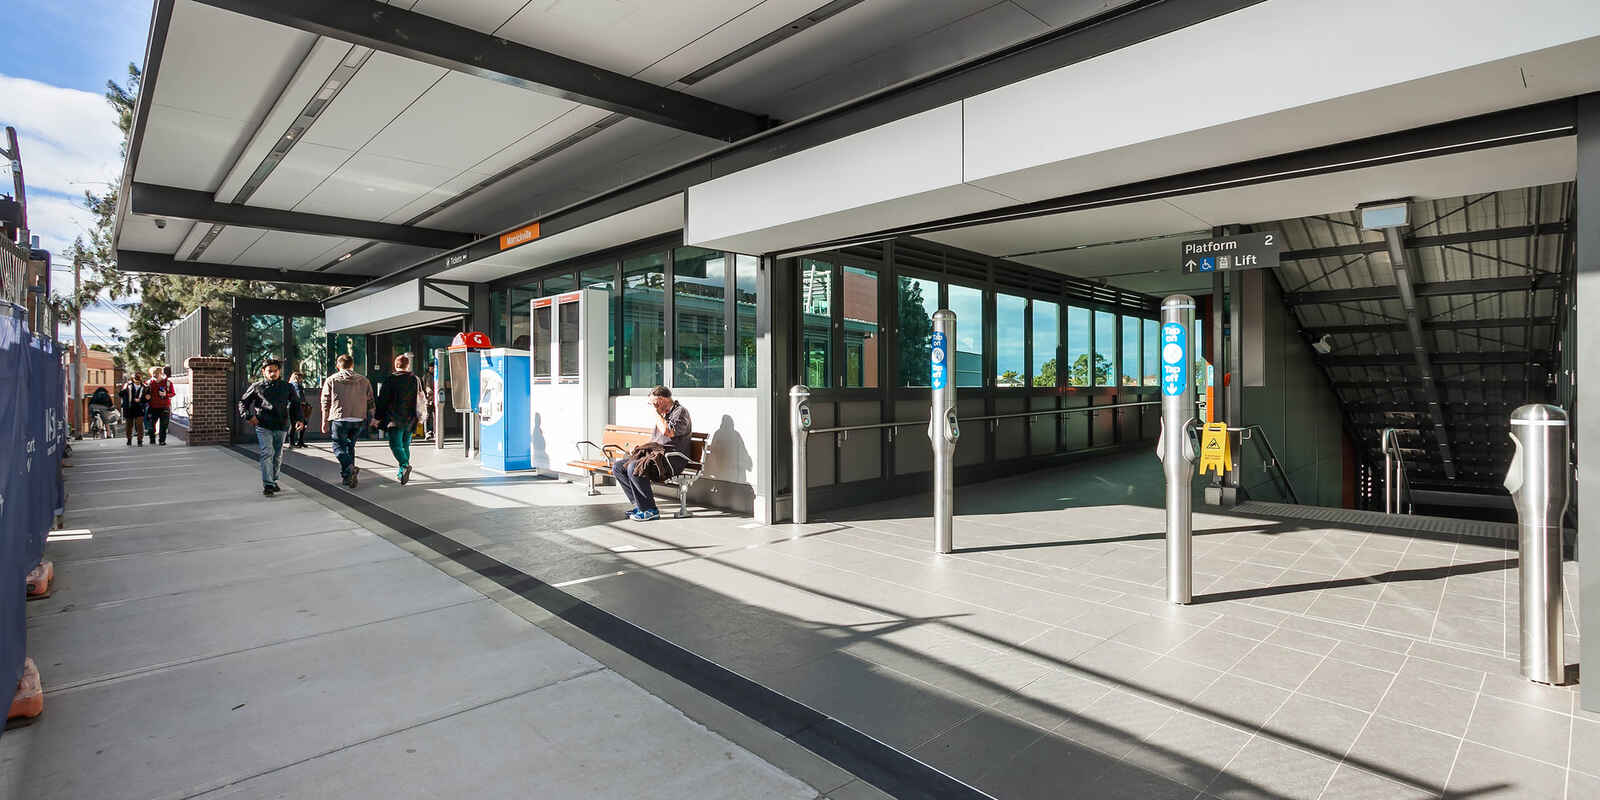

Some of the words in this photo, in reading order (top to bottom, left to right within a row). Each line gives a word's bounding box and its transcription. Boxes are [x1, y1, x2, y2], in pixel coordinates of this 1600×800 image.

[1185, 240, 1237, 255] Platform
[1264, 234, 1273, 246] 2
[1234, 254, 1257, 266] Lift
[1164, 326, 1181, 336] Tap
[1164, 365, 1181, 375] Tap
[1165, 374, 1178, 382] off
